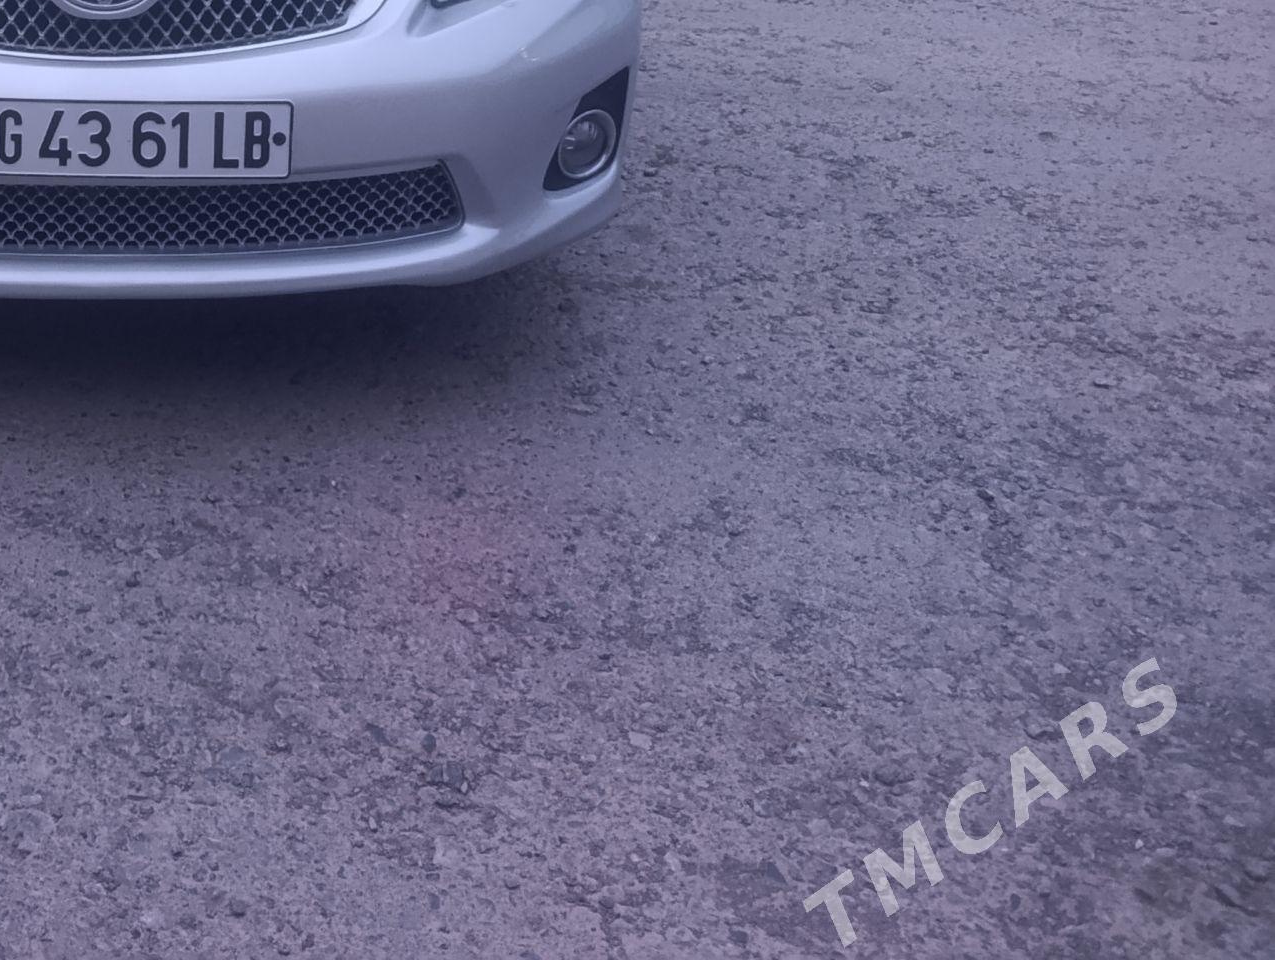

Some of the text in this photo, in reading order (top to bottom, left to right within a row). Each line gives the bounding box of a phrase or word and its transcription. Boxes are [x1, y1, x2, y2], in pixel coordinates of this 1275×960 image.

[38, 110, 112, 167] 43
[132, 111, 190, 169] 61
[213, 111, 271, 169] LB
